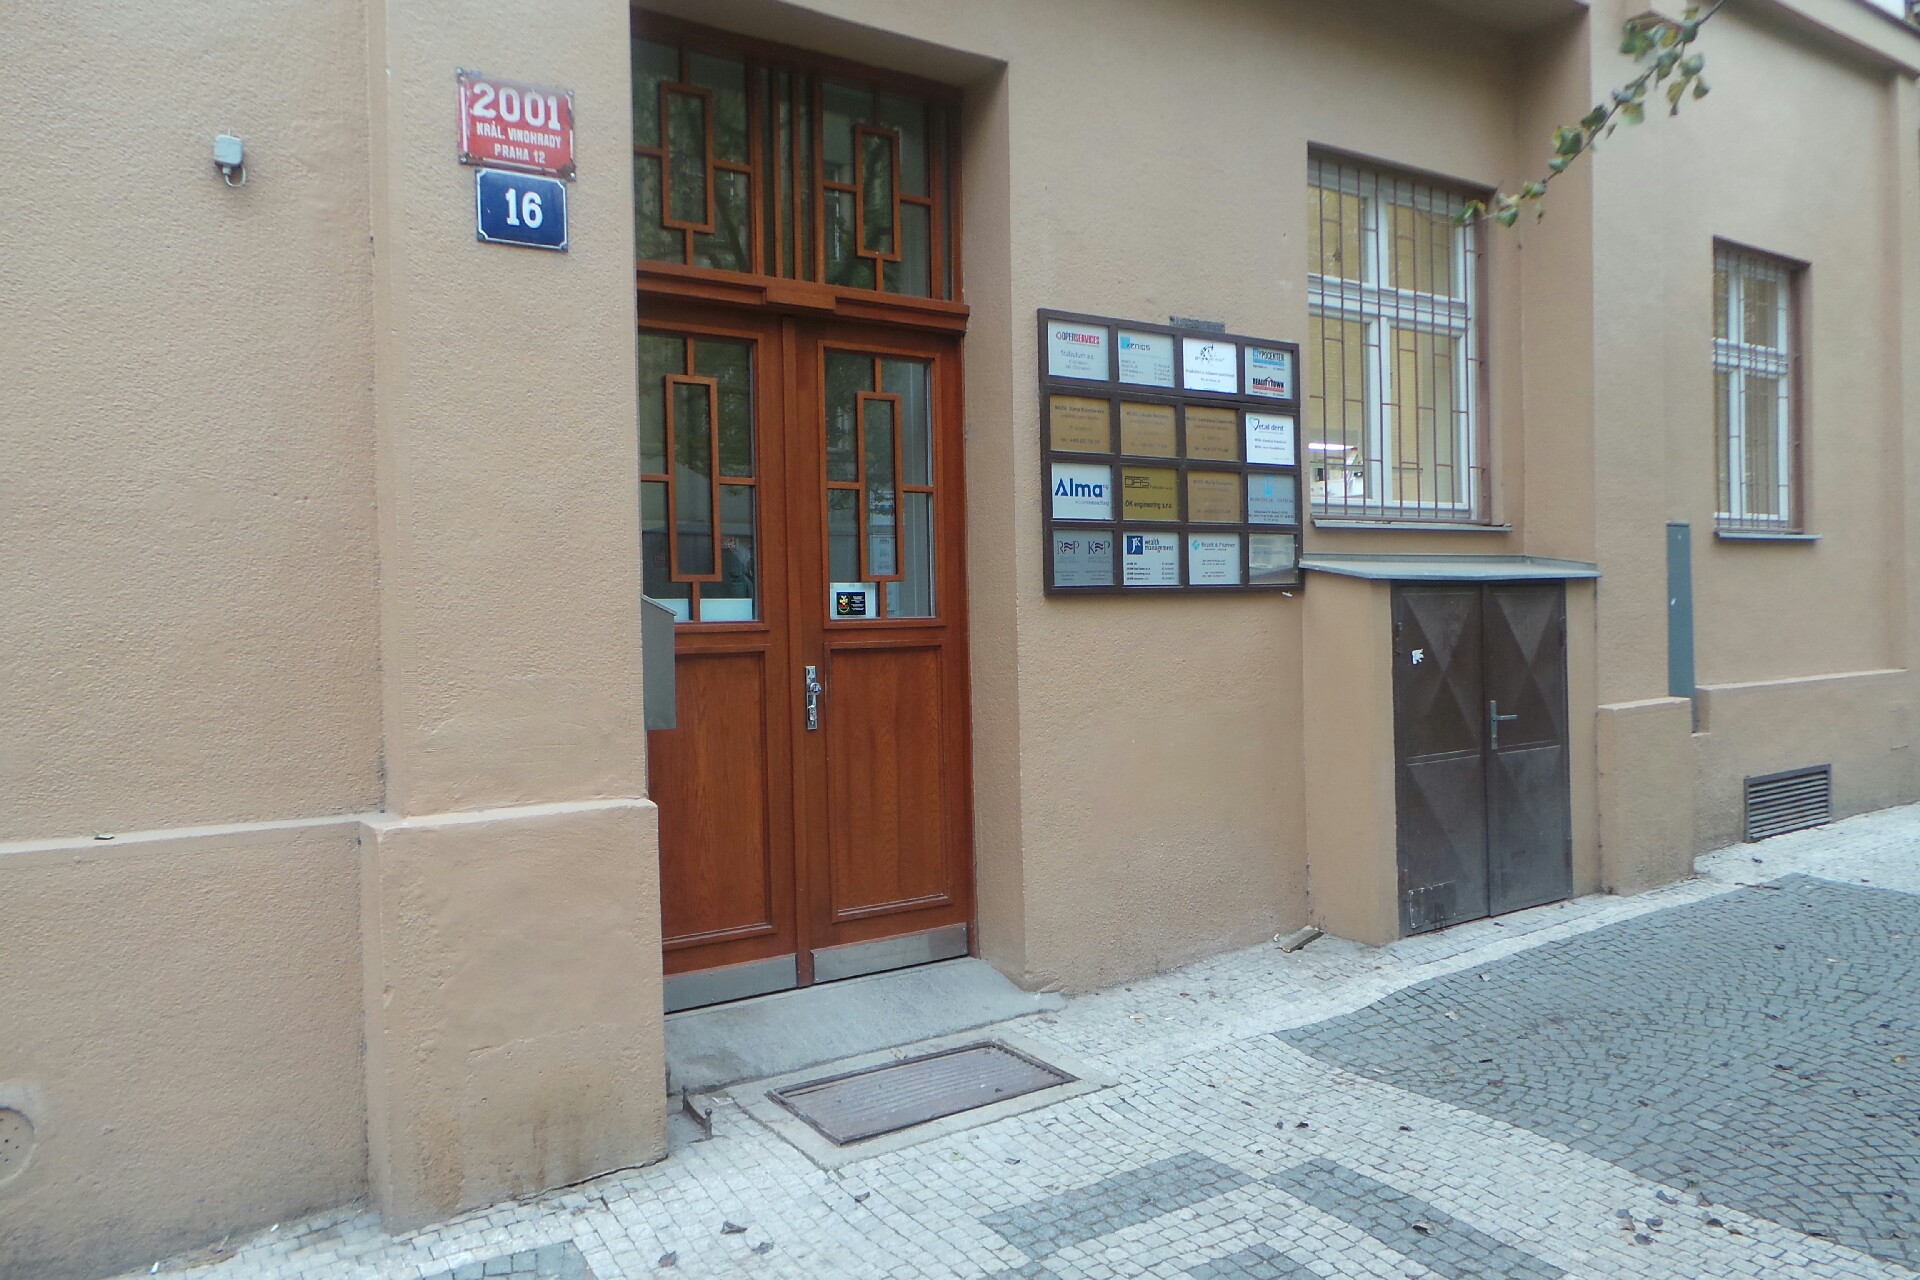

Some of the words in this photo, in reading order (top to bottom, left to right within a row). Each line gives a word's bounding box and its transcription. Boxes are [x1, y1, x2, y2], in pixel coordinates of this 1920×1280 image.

[473, 82, 561, 131] 2001
[508, 128, 562, 148] VINOHRADY
[494, 143, 530, 162] PRAHA
[533, 149, 545, 164] 12
[505, 188, 543, 228] 16
[1055, 478, 1103, 498] Alma
[1134, 502, 1161, 510] engineering
[1145, 545, 1174, 553] management
